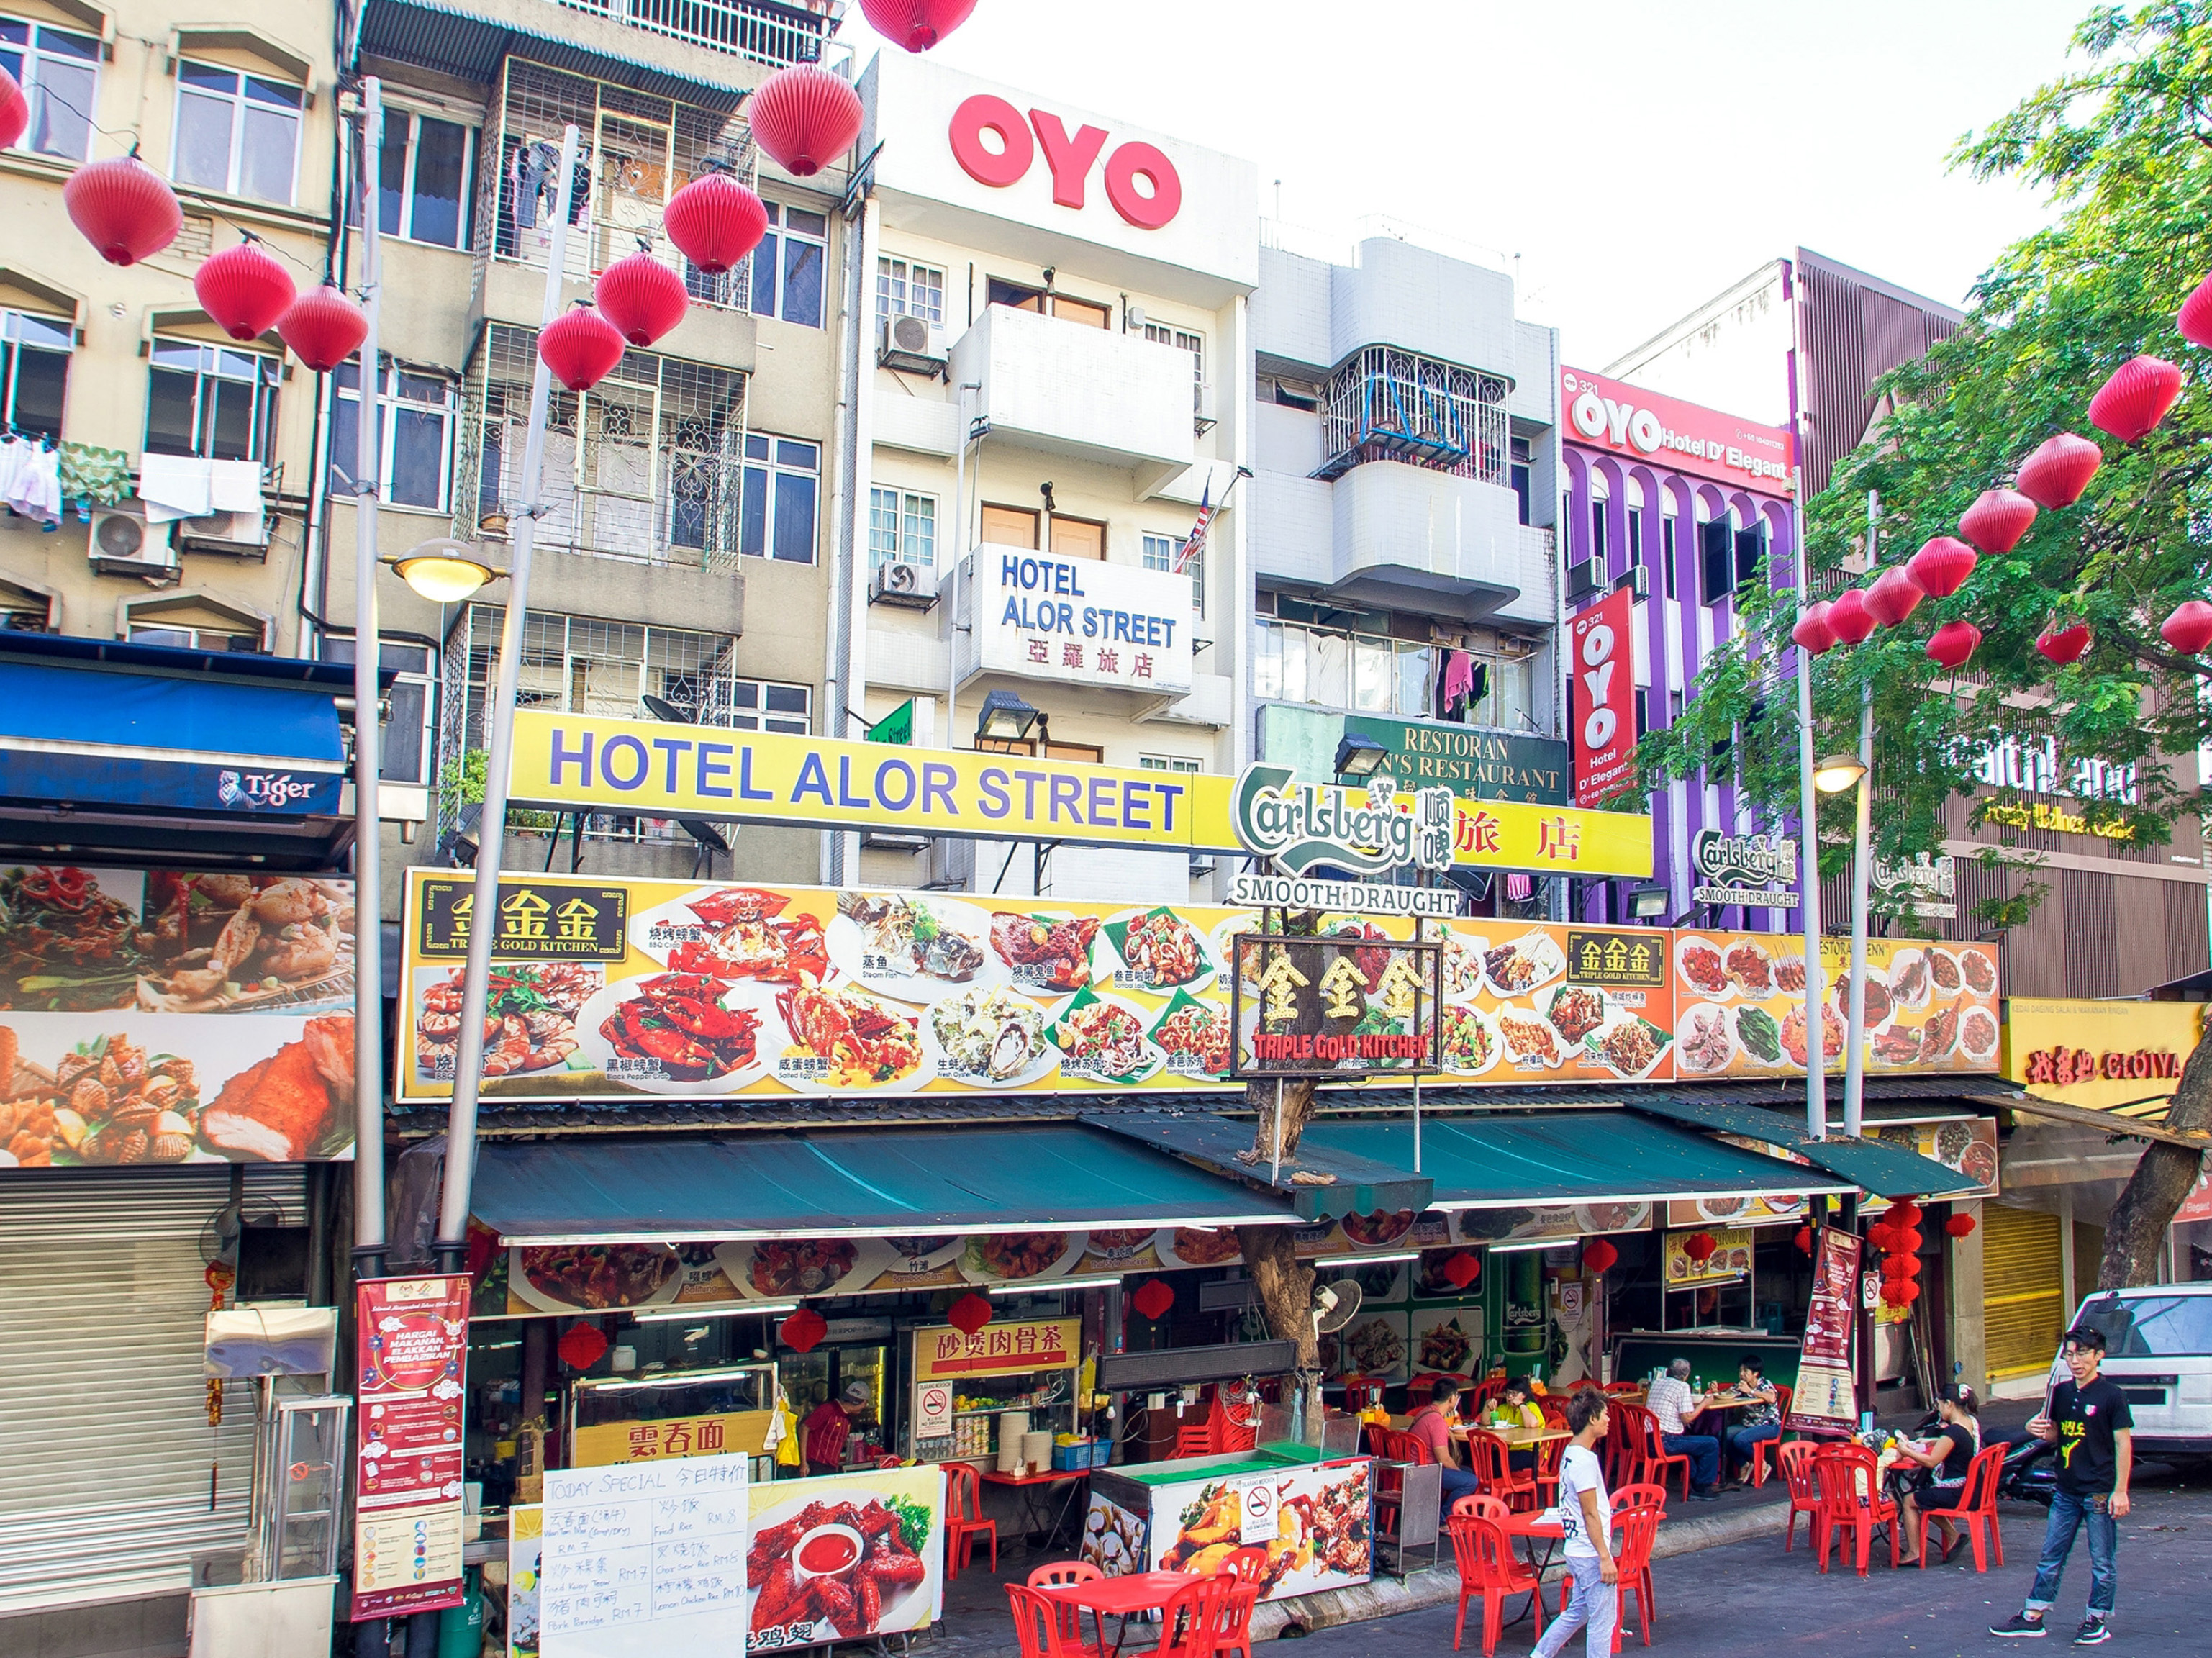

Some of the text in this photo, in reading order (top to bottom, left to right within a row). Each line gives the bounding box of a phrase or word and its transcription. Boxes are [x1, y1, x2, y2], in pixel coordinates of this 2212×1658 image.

[949, 94, 1182, 230] OYO
[1579, 379, 1598, 396] 321
[1572, 392, 1662, 454] OYO
[1662, 428, 1705, 457] Hotel
[1726, 447, 1787, 479] Elegant
[1002, 555, 1084, 597] HOTEL
[1002, 596, 1176, 648] ALOR STREET
[1588, 612, 1603, 628] 321
[1028, 639, 1153, 678] 亞羅旅店
[1405, 727, 1508, 761] RESTORAN
[1590, 748, 1616, 769] Hotel
[550, 729, 1184, 833] HOTEL ALOR STREET
[1419, 758, 1559, 789] RESTAURANT
[1591, 761, 1628, 786] Elegant
[245, 774, 315, 807] Tiger
[1236, 765, 1413, 864] Carlsberg
[1699, 829, 1777, 876] Carlsberg
[1237, 878, 1456, 915] SMOOTH DRAUGHT
[1699, 888, 1798, 906] SMOOTH DRAUGHT
[501, 941, 599, 952] GOLD KITCHEN
[1579, 938, 1651, 972] 金金金
[1819, 940, 1885, 957] ESTORA ENN
[1259, 956, 1423, 1020] 金金金
[1254, 1034, 1428, 1061] TRIPLE GOLD KITCHEN
[893, 1272, 945, 1283] Bamboo Clam
[1091, 1260, 1104, 1269] Thai
[1122, 1257, 1149, 1267] Chicken
[1508, 1301, 1541, 1320] Carlsberg
[396, 1330, 437, 1340] HARGAI
[937, 1326, 1063, 1360] 砂煲肉骨茶
[383, 1351, 451, 1364] PEMBAZIRAN
[391, 1345, 441, 1356] ELAKKAN
[629, 1419, 725, 1457] 雲吞面
[548, 1480, 593, 1499] TODAY
[599, 1473, 666, 1493] SPECIAL
[654, 1522, 674, 1536] Fried
